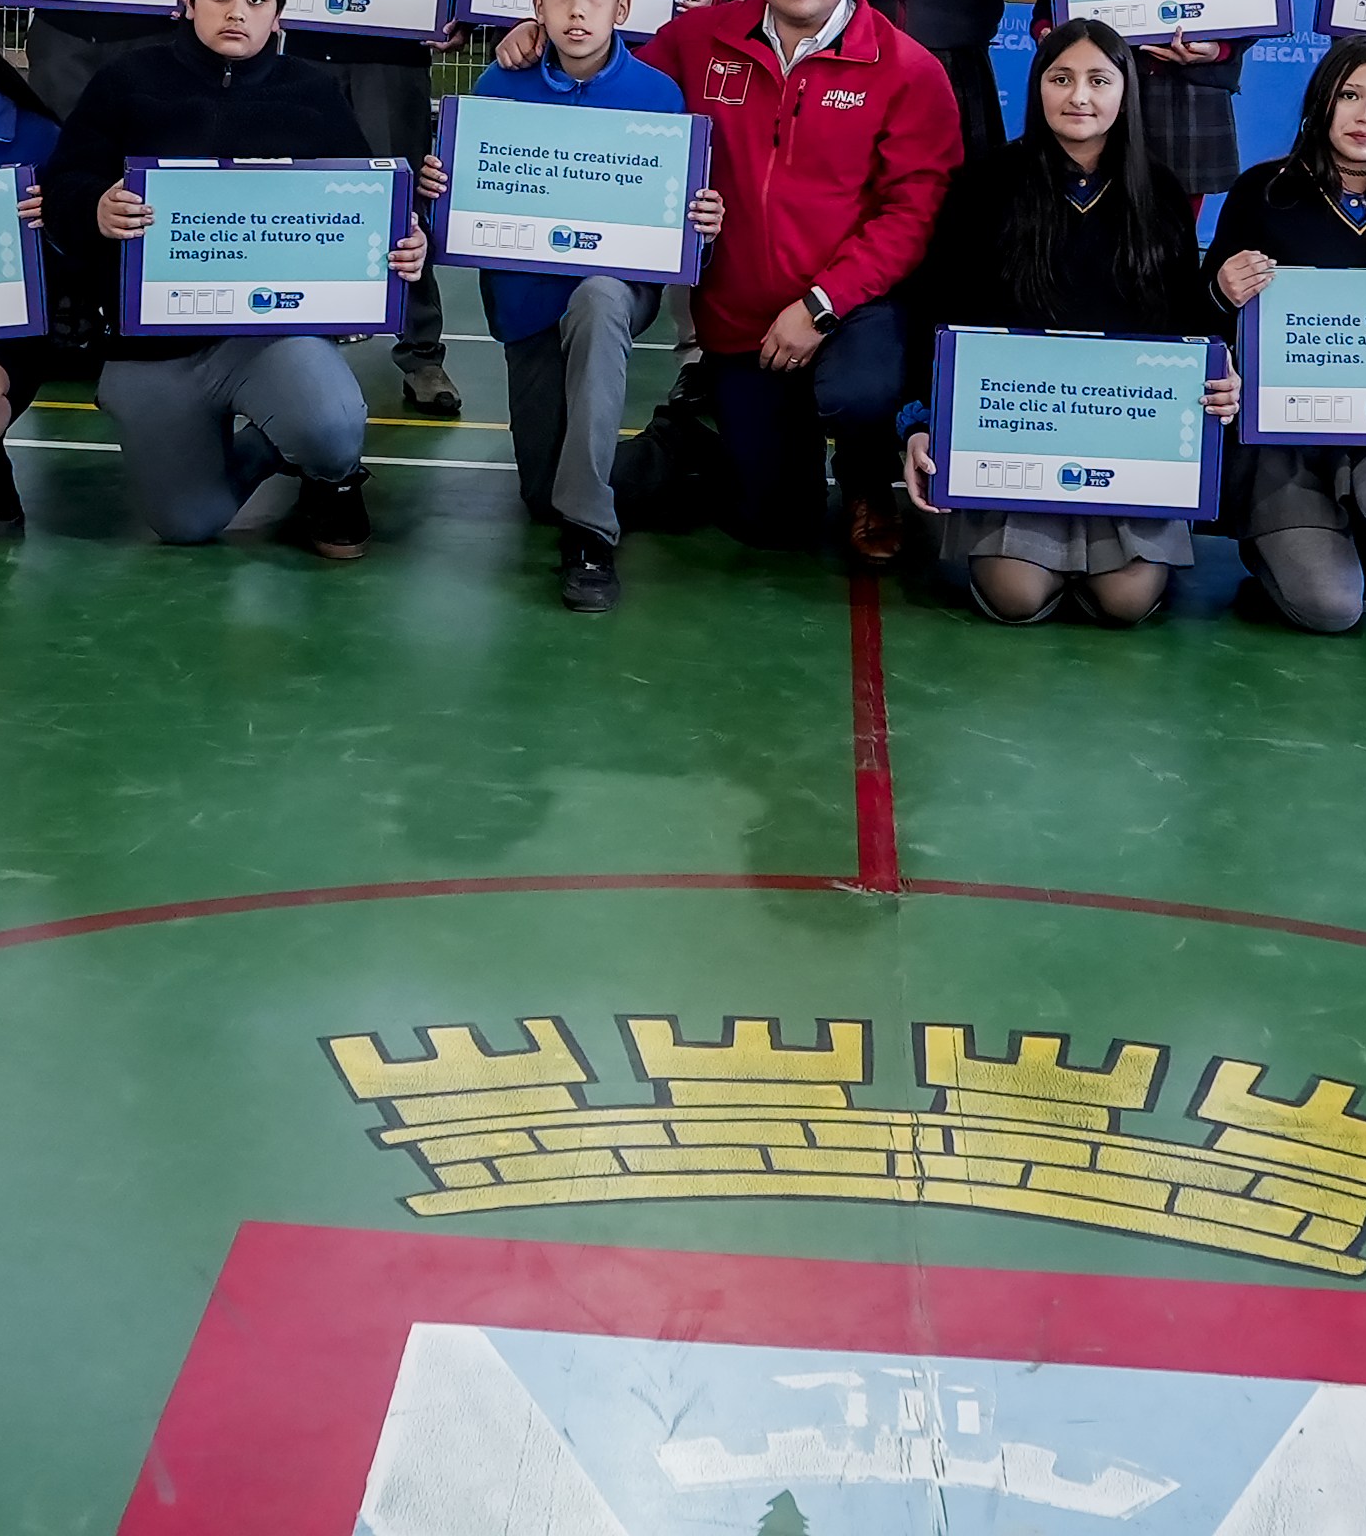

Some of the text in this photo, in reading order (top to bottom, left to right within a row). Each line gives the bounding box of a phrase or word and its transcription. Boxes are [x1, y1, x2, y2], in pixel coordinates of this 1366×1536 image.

[992, 34, 1033, 50] ECA
[1252, 46, 1305, 63] BECA
[478, 141, 663, 168] Enciende tu creatividad.
[477, 159, 643, 186] Dale clic al futuro que
[476, 176, 550, 195] imaginas.
[170, 211, 365, 225] Enciende tu creatividad.
[170, 229, 345, 245] Dale clic al futuro que
[169, 247, 248, 263] imaginas.
[1285, 313, 1361, 327] Enciende
[1285, 331, 1322, 345] Dale
[1325, 332, 1354, 346] clic
[1285, 350, 1364, 367] imaginas.
[980, 378, 1178, 401] Enciende tu creatividad.
[979, 396, 1157, 420] Dale clic al futuro que
[978, 415, 1058, 433] imaginas.
